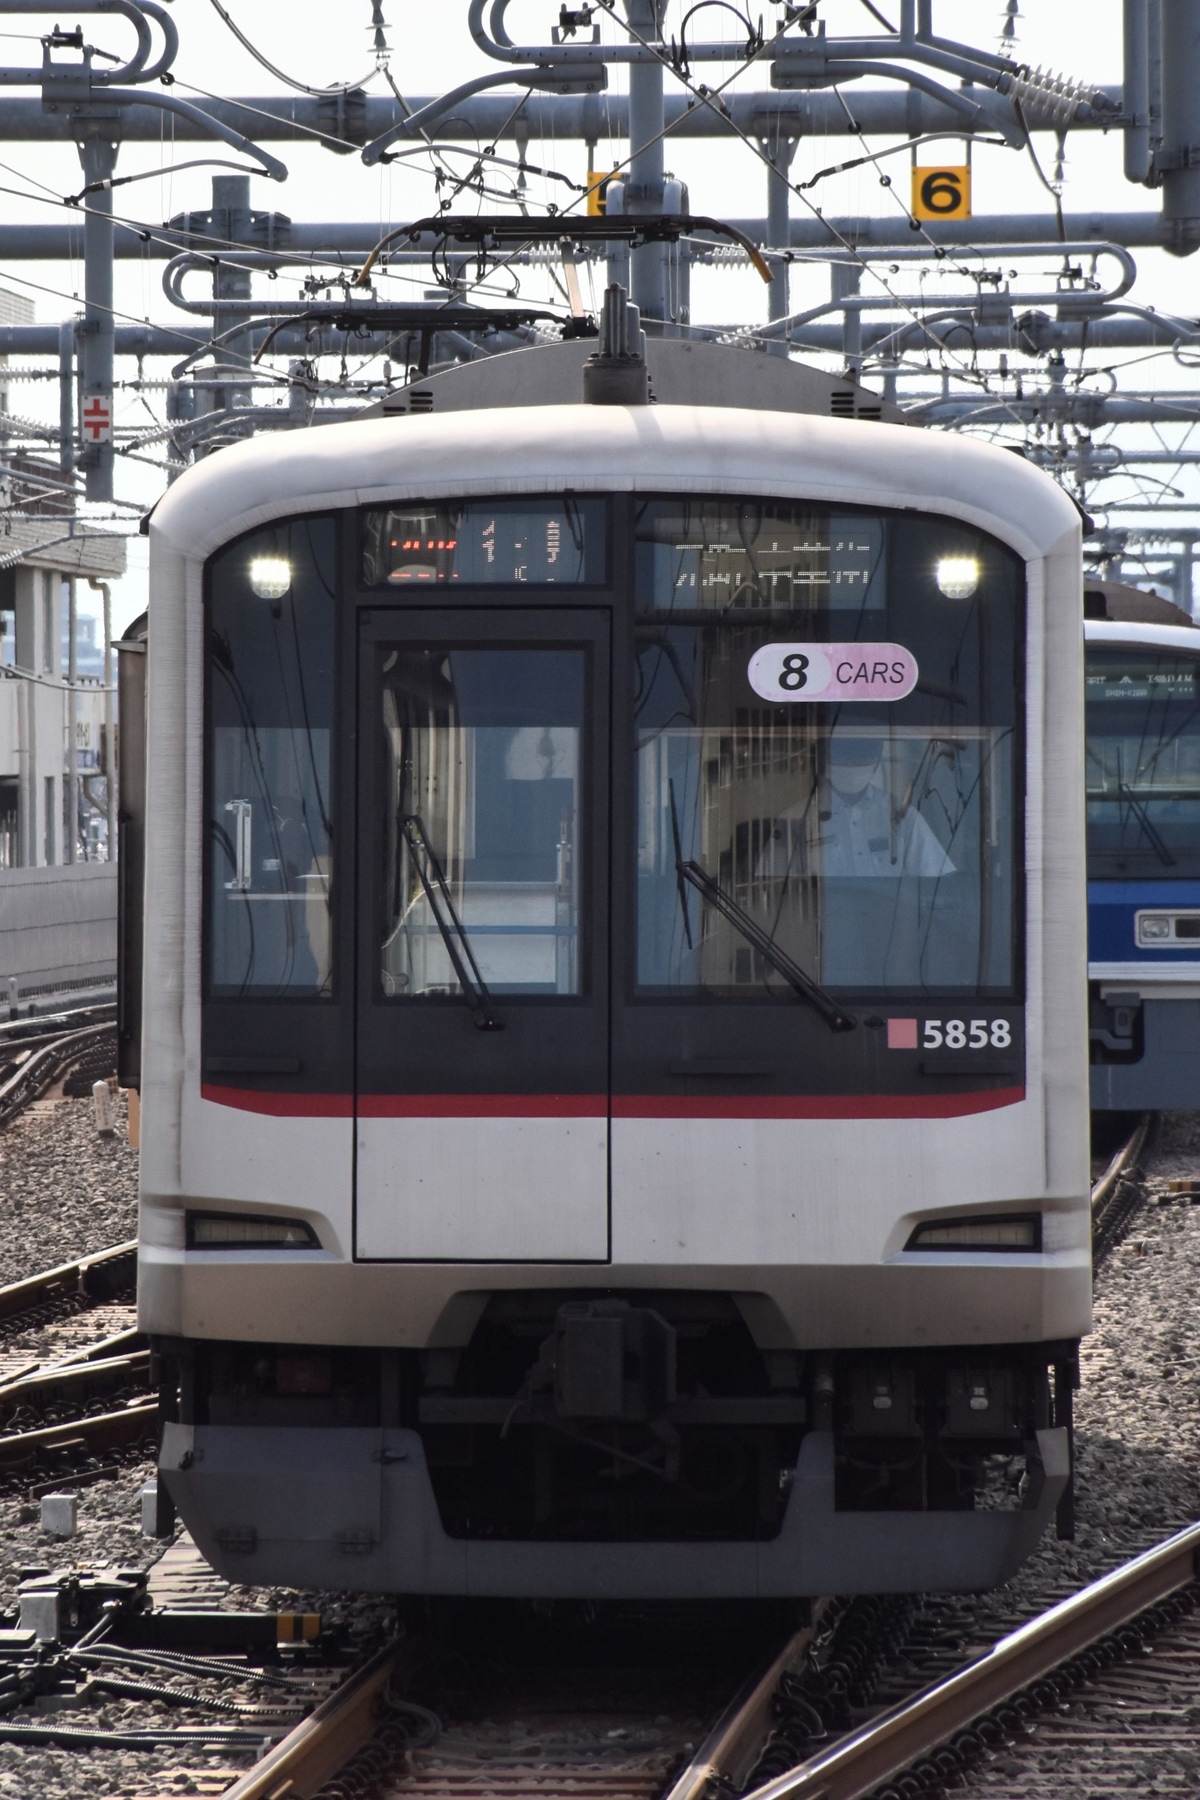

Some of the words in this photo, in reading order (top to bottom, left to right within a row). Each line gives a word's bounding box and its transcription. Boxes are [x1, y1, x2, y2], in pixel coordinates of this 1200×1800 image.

[921, 171, 962, 214] 6
[778, 653, 810, 691] 8
[836, 662, 905, 684] CARS
[923, 1019, 1012, 1049] 5858
